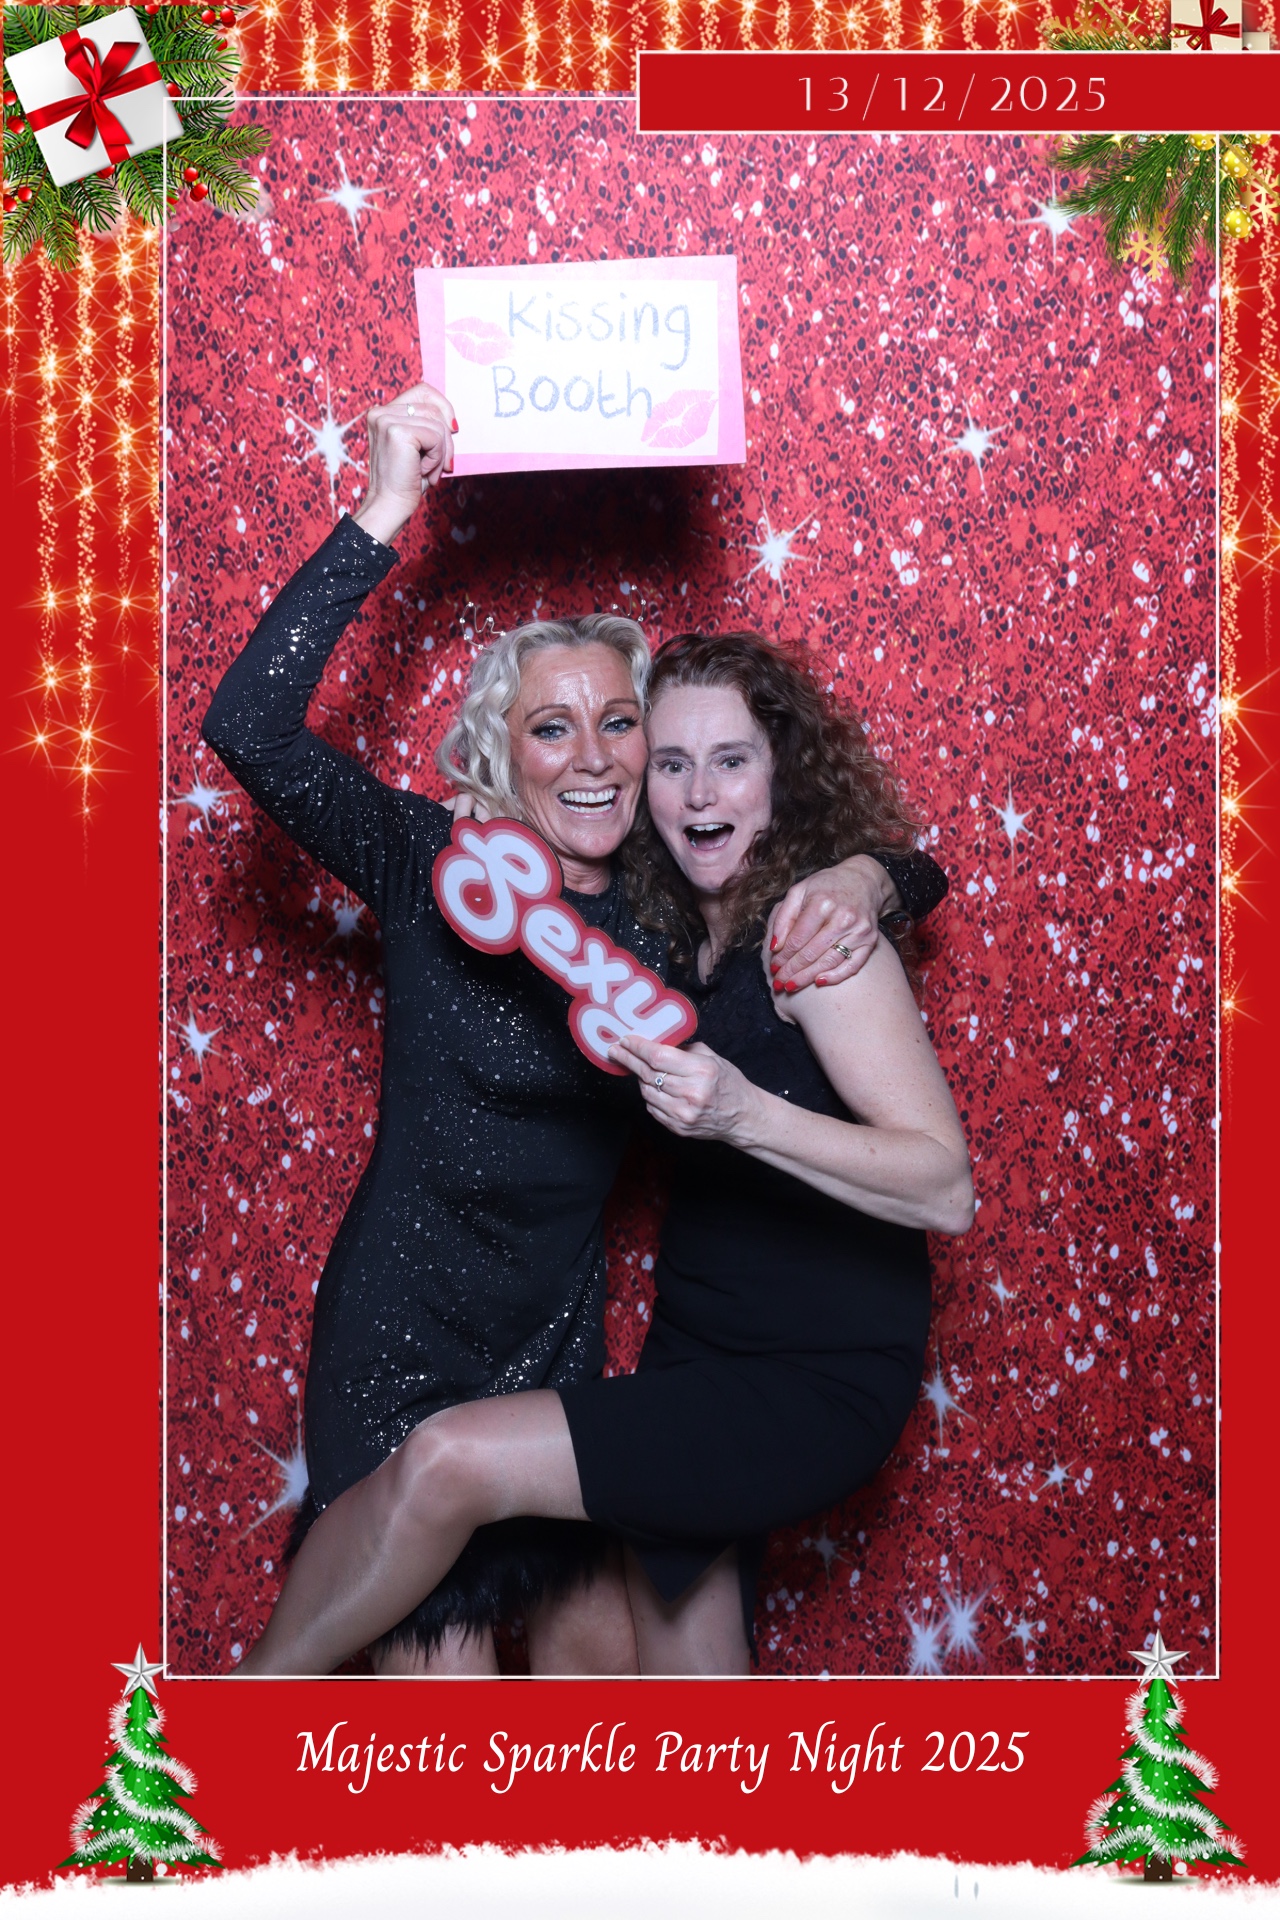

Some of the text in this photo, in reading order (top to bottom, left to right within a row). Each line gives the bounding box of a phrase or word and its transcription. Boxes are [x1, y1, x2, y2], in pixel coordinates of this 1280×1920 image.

[508, 290, 691, 370] Kissing
[491, 365, 653, 419] Booth
[442, 832, 683, 1058] Sexy
